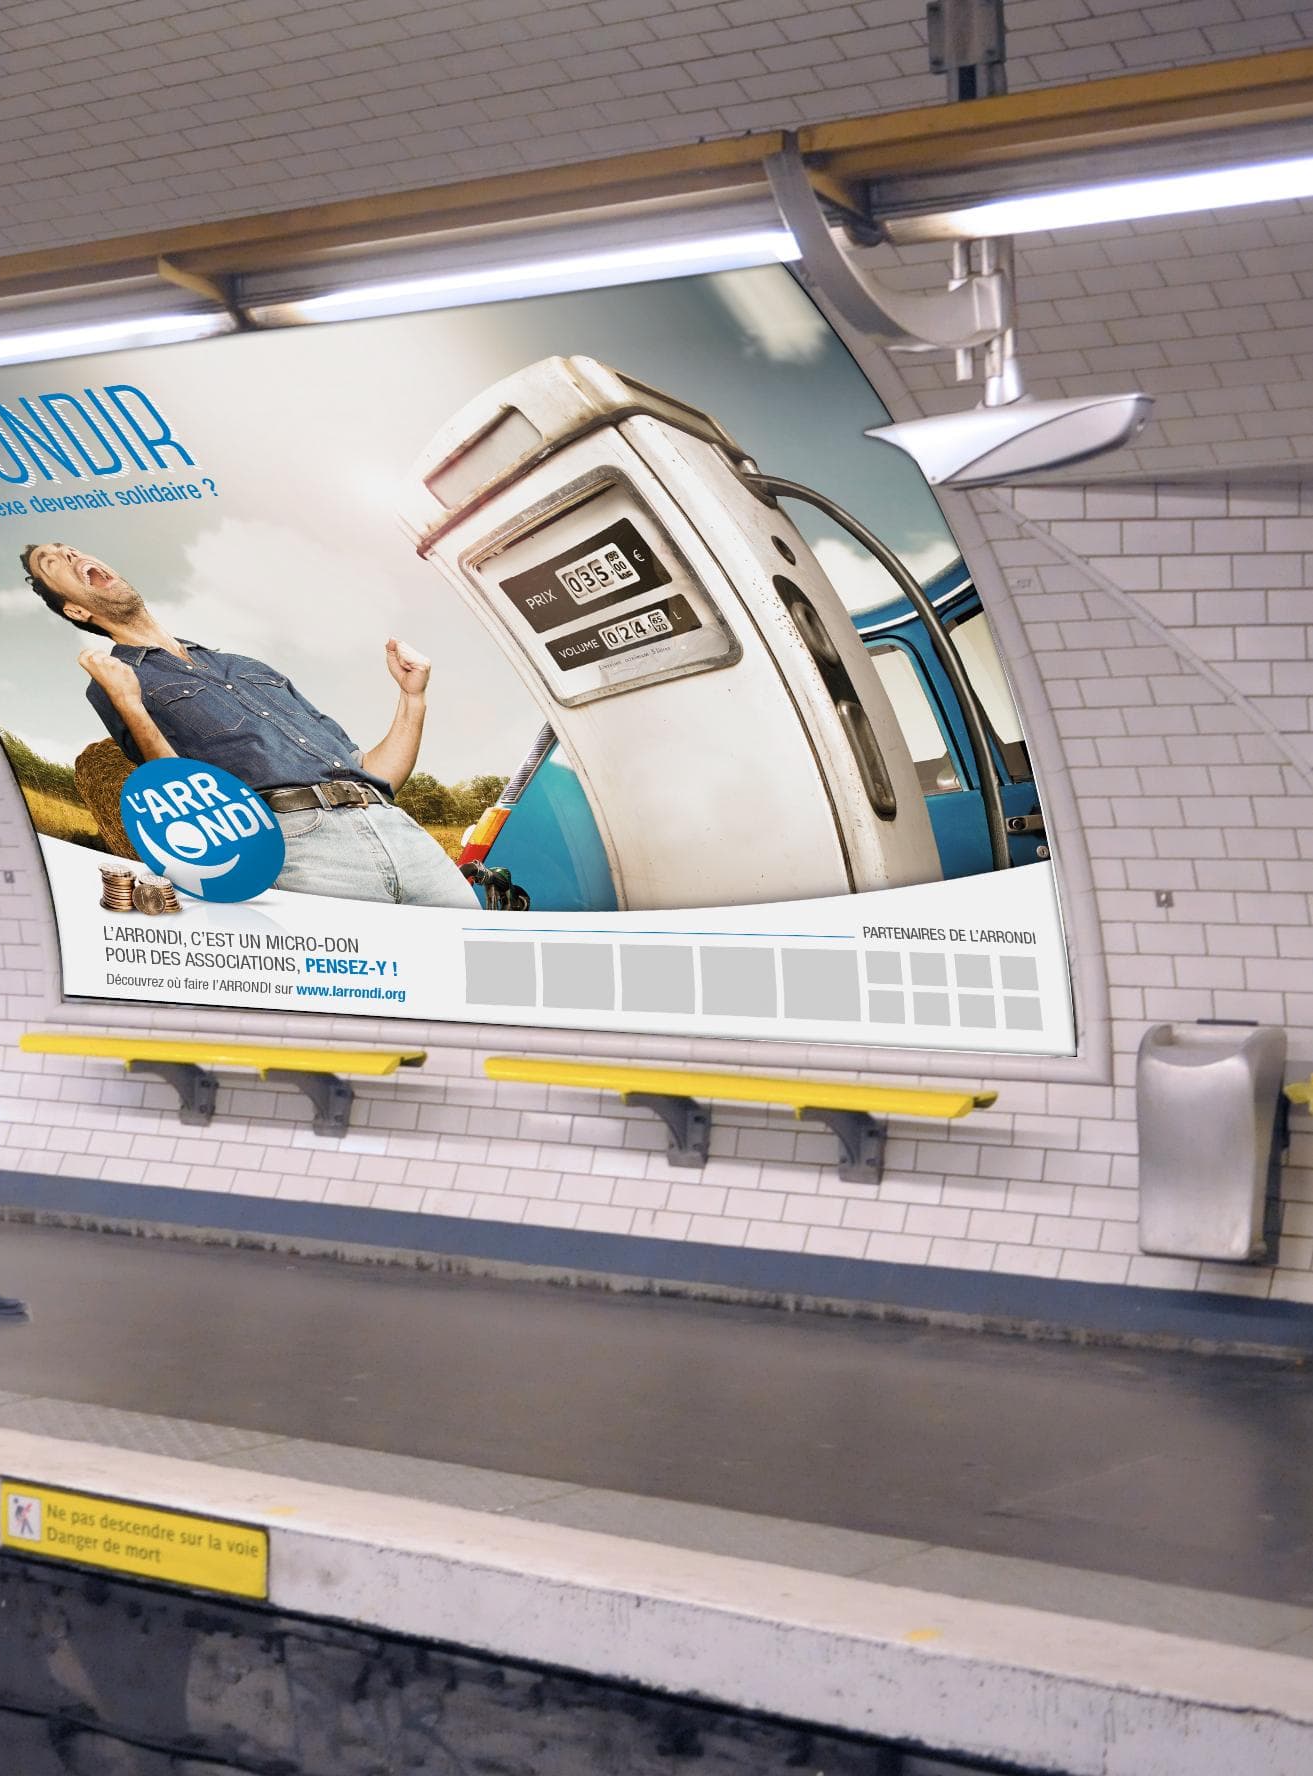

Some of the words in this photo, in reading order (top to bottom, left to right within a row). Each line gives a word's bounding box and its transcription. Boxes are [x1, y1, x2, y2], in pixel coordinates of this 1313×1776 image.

[30, 490, 116, 514] devenait
[117, 482, 203, 507] solidaire
[202, 477, 219, 497] ?
[525, 588, 558, 610] PRIX
[558, 639, 600, 659] VOLUME
[126, 772, 231, 824] L'ARR
[103, 925, 187, 948] L'ARRONDI,
[191, 931, 234, 949] C'EST
[239, 933, 261, 949] UN
[266, 934, 359, 954] MICRO-DON
[863, 926, 946, 942] PARTENAIRES
[949, 928, 967, 942] DE
[970, 930, 1037, 945] L'ARRONDI
[105, 947, 146, 965] POUR
[151, 949, 181, 966] DES
[185, 951, 301, 975] ASSOCIATIONS,
[305, 957, 387, 977] PENSEZ-Y
[392, 961, 399, 977] !
[106, 973, 165, 989] Découvrez
[167, 976, 181, 989] où
[184, 977, 209, 991] faire
[212, 979, 272, 994] l'ARRONDI
[274, 984, 295, 996] sur
[296, 985, 407, 1003] www.larrondi.org
[47, 1504, 66, 1522] Ne
[71, 1511, 95, 1527] pas
[100, 1512, 175, 1543] descendre
[179, 1531, 204, 1547] sur
[208, 1533, 222, 1551] la
[227, 1540, 259, 1558] voie
[47, 1527, 98, 1551] Danger
[102, 1538, 120, 1555] de
[125, 1546, 161, 1562] mort
